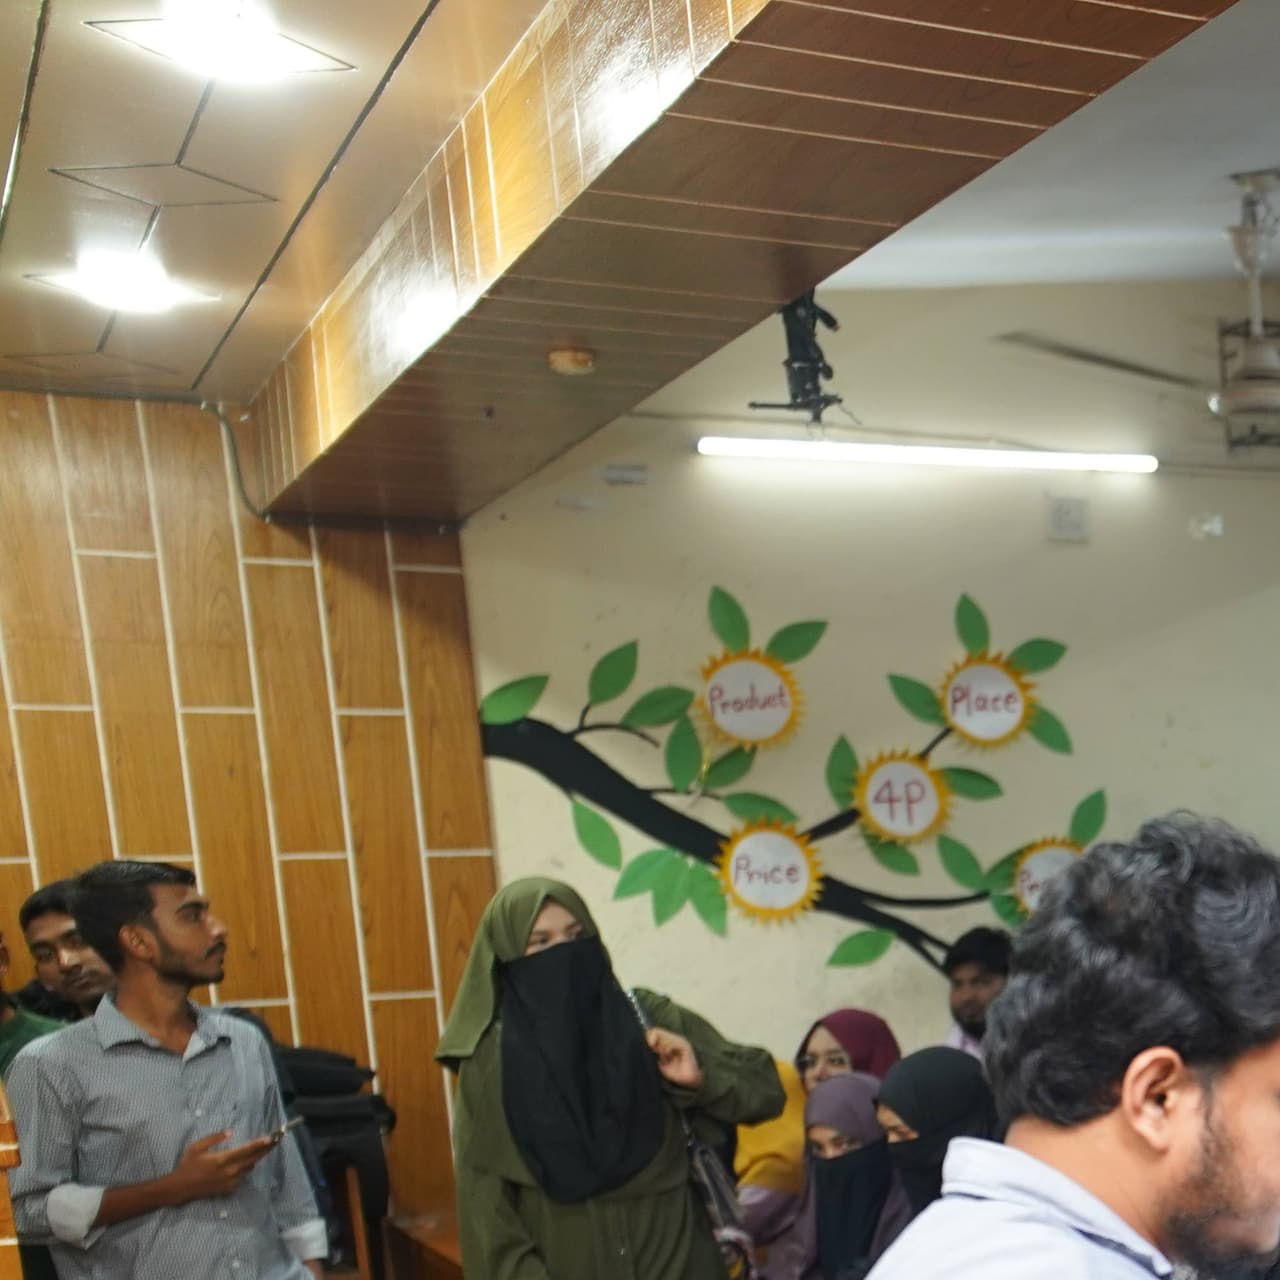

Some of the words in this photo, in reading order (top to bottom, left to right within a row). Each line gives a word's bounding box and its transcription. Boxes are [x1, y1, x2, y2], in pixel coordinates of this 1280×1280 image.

[708, 683, 789, 718] Product
[951, 683, 1017, 717] Place
[873, 779, 926, 826] 4P
[735, 854, 800, 886] Price
